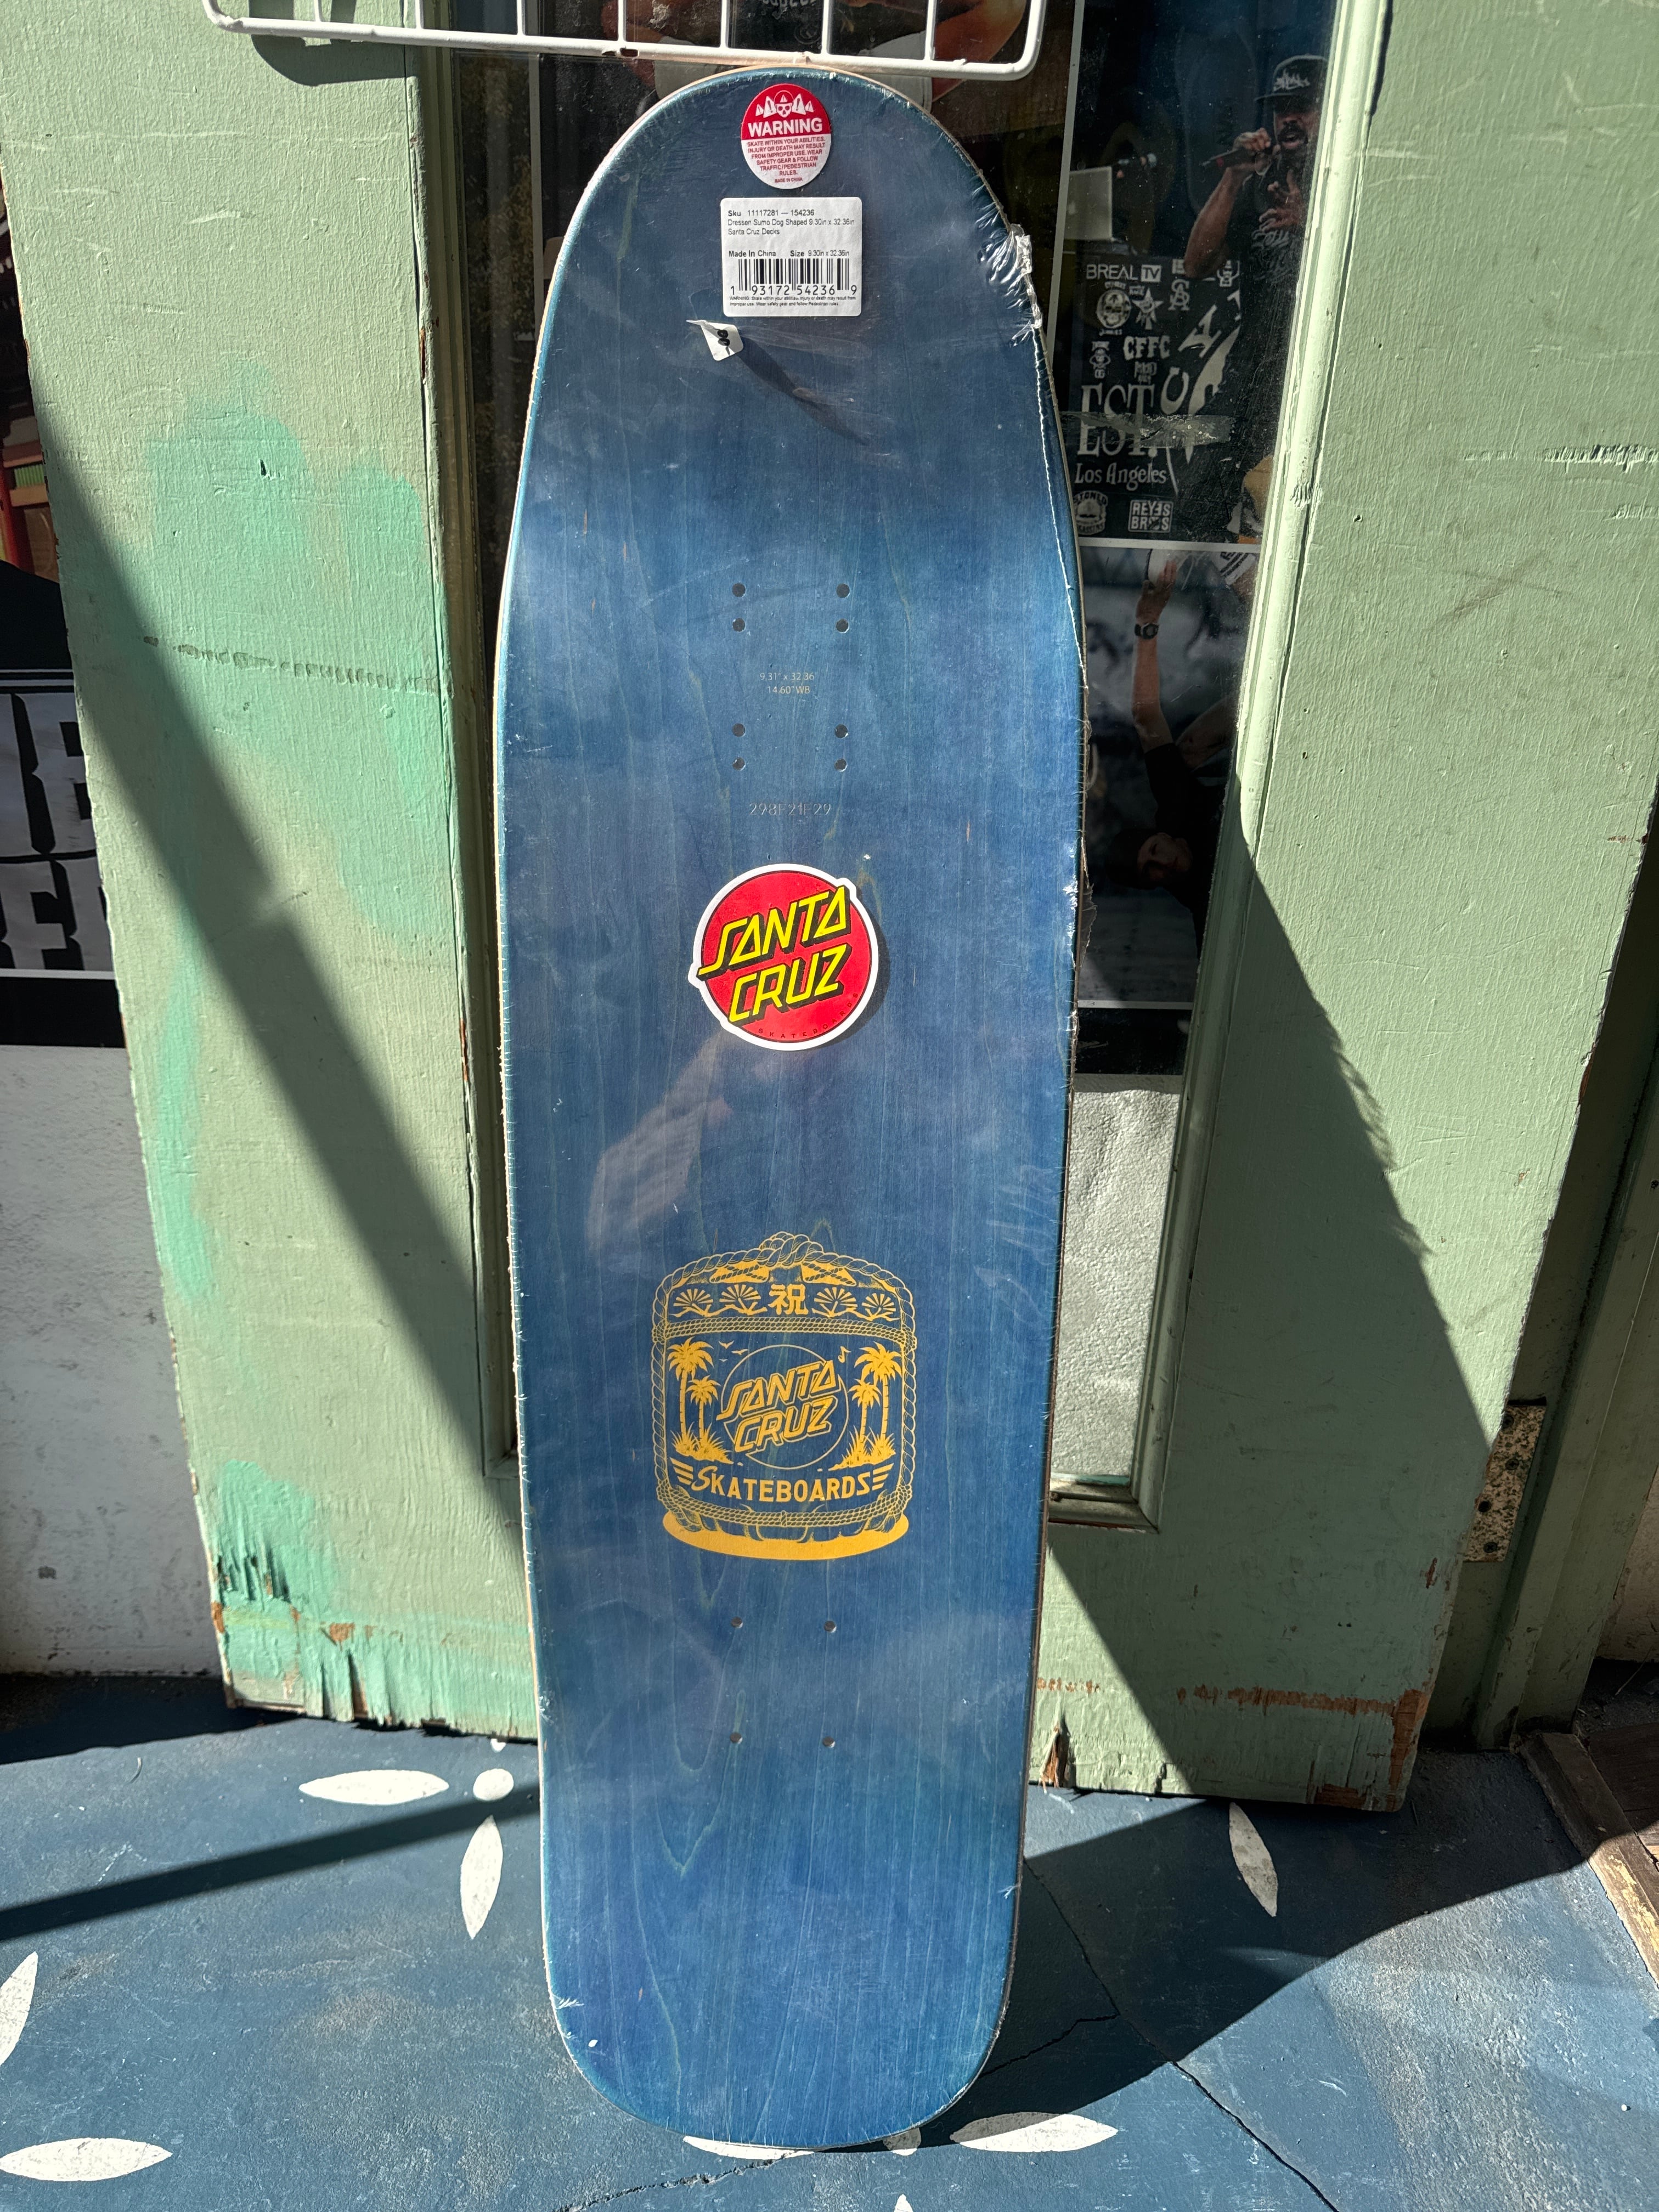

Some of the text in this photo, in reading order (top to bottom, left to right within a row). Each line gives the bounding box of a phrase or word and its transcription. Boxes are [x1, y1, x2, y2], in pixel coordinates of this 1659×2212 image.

[748, 117, 822, 137] WARNING
[760, 162, 816, 171] TRAFFIC/PEDESTRIAN
[786, 218, 808, 227] Shaped
[1086, 264, 1138, 280] BREAL
[1141, 266, 1161, 280] TV
[730, 285, 857, 295] 1 93172 54236 9
[1123, 335, 1171, 360] CFFC
[1074, 462, 1167, 491] Los Angeles
[1132, 500, 1171, 516] REYES
[796, 686, 810, 694] WB
[697, 885, 850, 979] SANTA
[728, 944, 850, 1024] CRUZ
[759, 993, 858, 1039] SKATEBOARDS
[769, 1284, 809, 1315] 祝
[716, 1360, 840, 1420] SANTA
[734, 1396, 837, 1453] CRUZ
[691, 1465, 871, 1502] SKATEBOARDS
